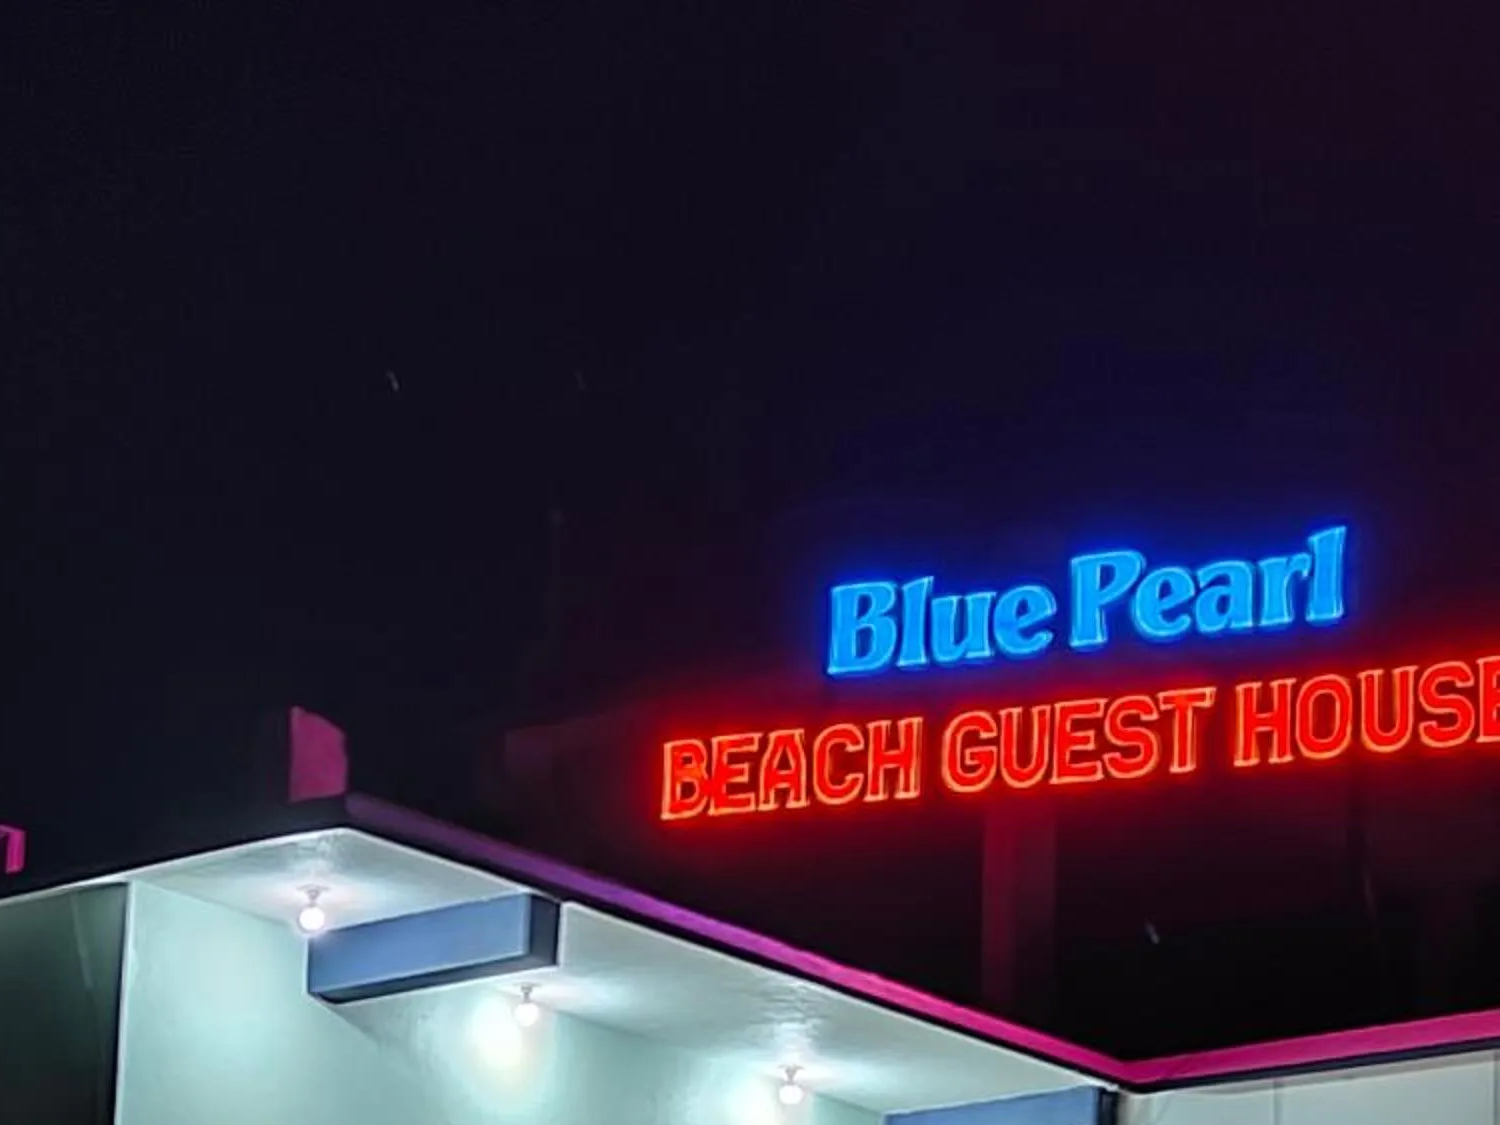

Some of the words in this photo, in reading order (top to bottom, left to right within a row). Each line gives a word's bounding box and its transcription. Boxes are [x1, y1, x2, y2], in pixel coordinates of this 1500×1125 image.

[827, 576, 1056, 675] Blue
[1068, 526, 1347, 647] Pearl
[660, 716, 924, 820] BEACH
[941, 687, 1216, 792] GUEST
